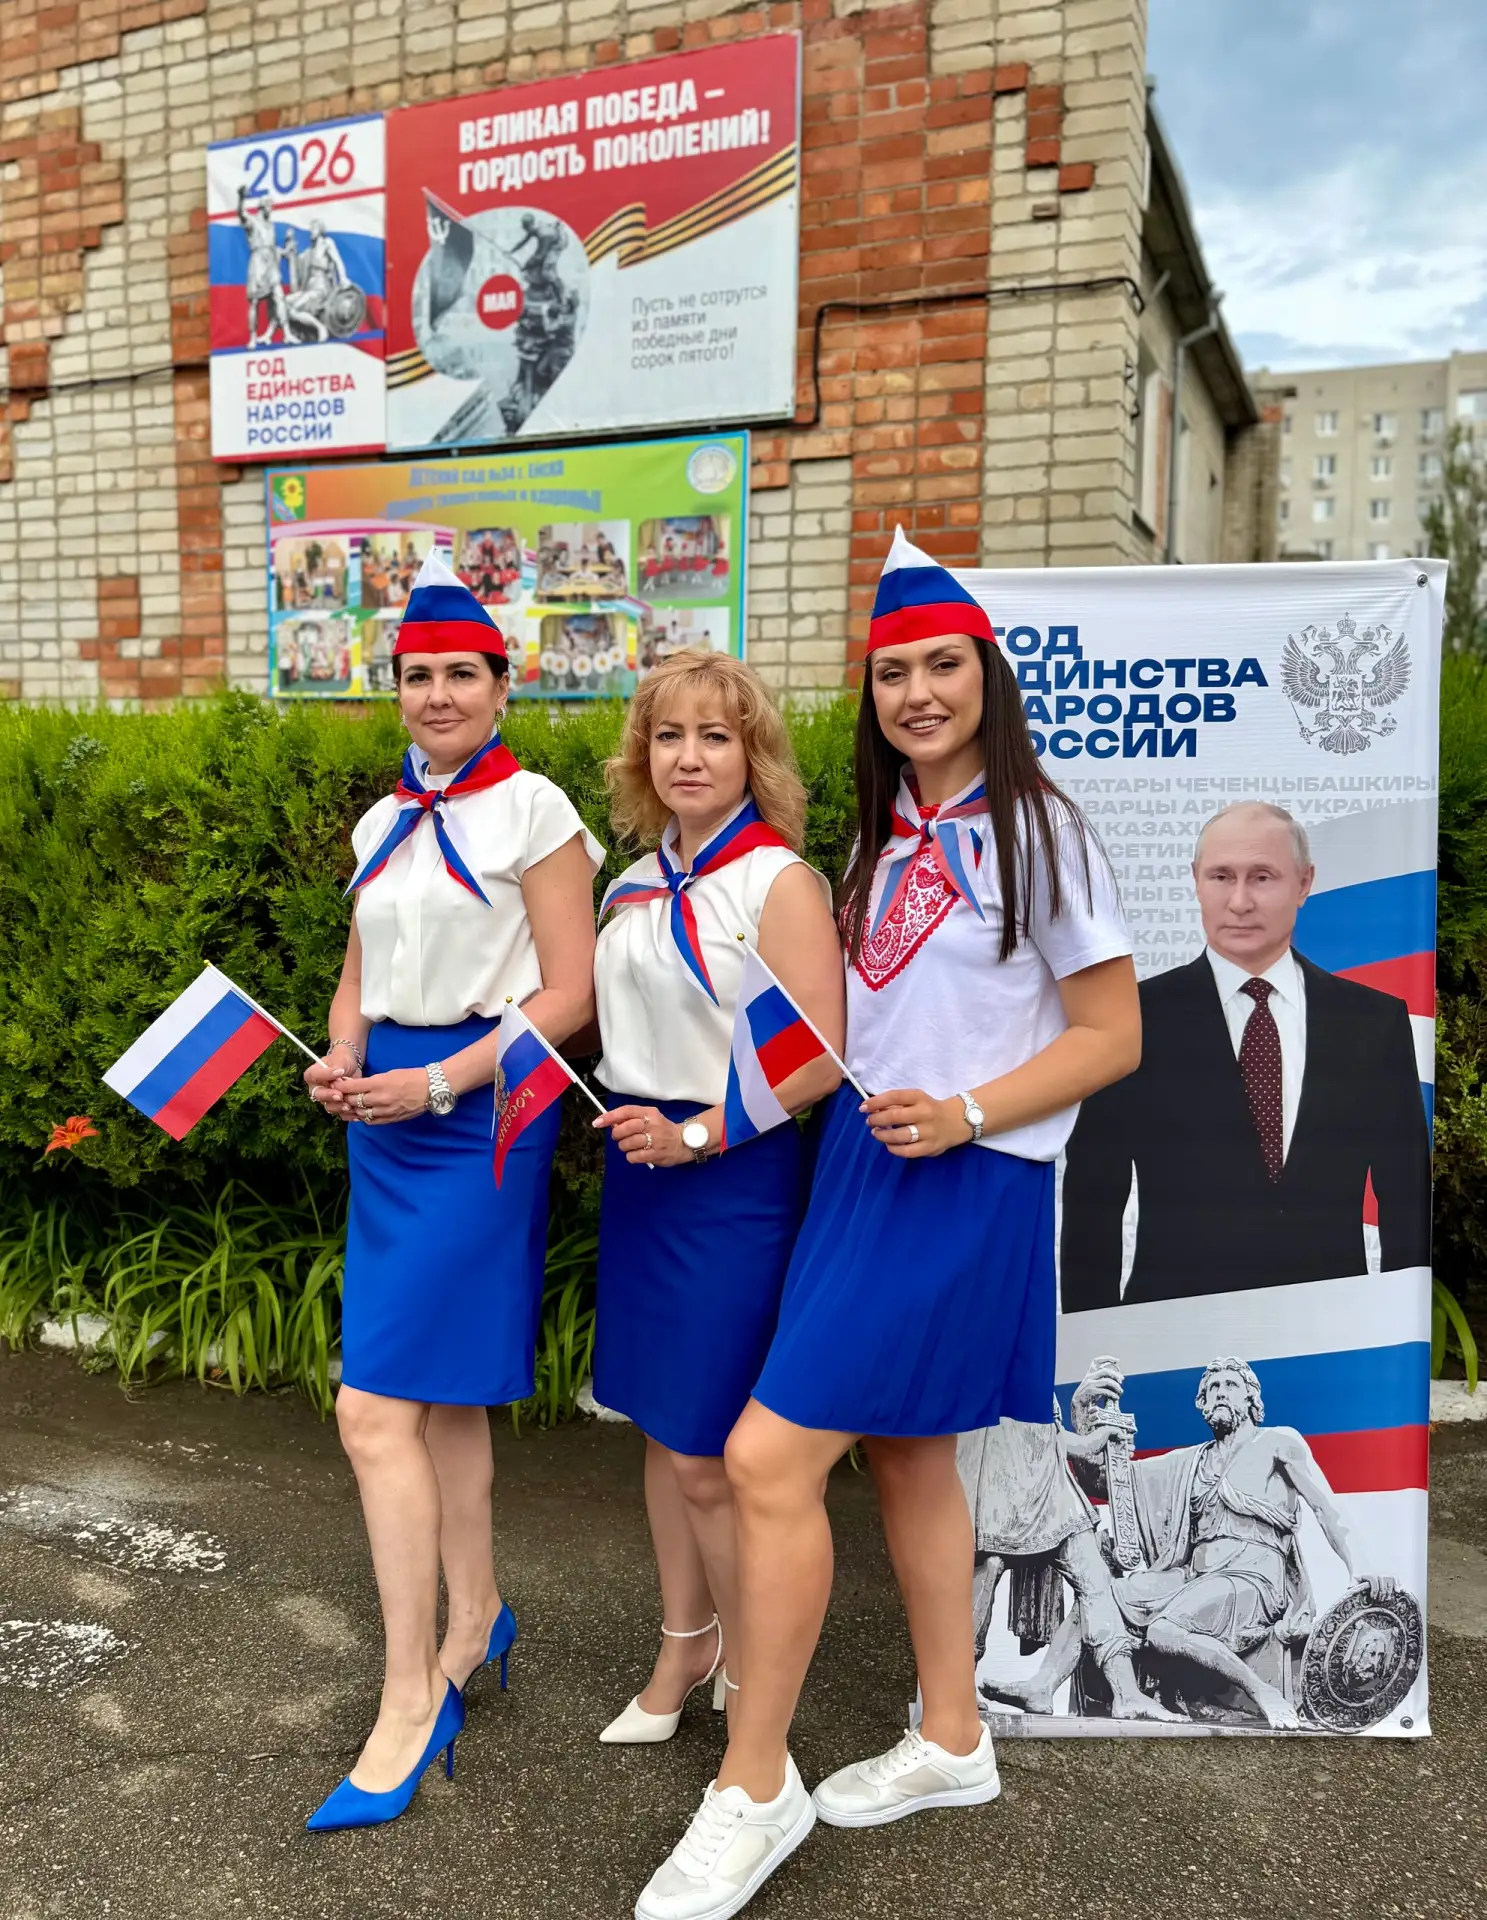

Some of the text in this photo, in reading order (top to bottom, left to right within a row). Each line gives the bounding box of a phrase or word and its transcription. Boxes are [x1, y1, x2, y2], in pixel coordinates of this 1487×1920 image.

[459, 100, 579, 153] ВЕЛИКАЯ
[585, 78, 699, 130] ПОБЕДА
[459, 108, 771, 195] ГОРДОСТЬ ПОКОЛЕНИЙ!
[244, 133, 356, 199] 2026
[632, 285, 767, 316] Пусть не сотрутся
[632, 312, 705, 332] из памяти
[632, 327, 737, 351] победные дни
[246, 357, 285, 377] ГОД
[631, 342, 734, 370] сорок пятого!
[246, 373, 356, 402] ЕДИНСТВА
[246, 397, 345, 423] НАРОДОВ
[247, 421, 332, 446] РОССИИ
[992, 626, 1083, 661] ОД
[1017, 658, 1269, 696] ДИНСТВА
[1023, 693, 1237, 729] АРОДОВ
[1029, 728, 1197, 760] ОССИИ
[1070, 778, 1170, 793] ТАТАРЫ
[1082, 800, 1175, 817] ВАРЦЫ
[1108, 843, 1195, 858] СЕТИН
[1133, 930, 1203, 944] КАРА
